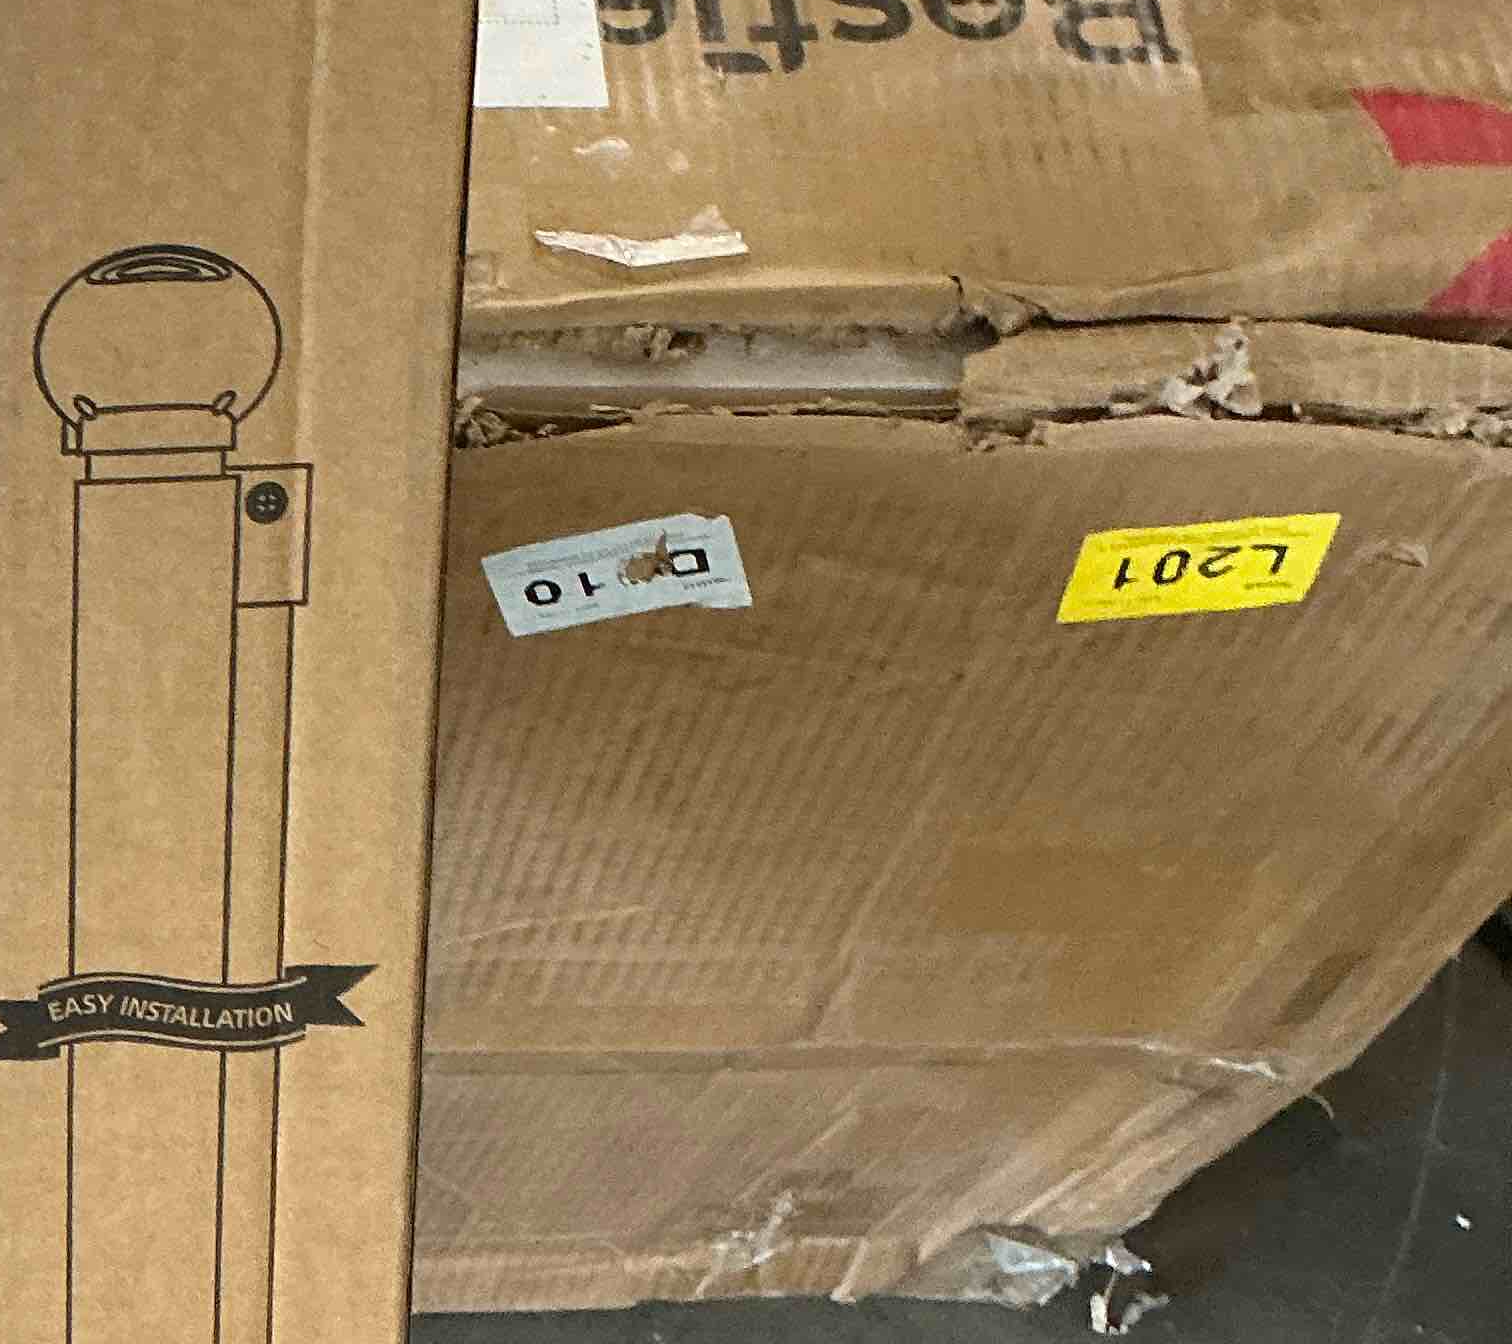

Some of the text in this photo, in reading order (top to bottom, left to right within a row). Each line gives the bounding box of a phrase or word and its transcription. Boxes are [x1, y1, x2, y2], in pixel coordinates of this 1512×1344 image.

[1112, 544, 1290, 591] L201
[47, 992, 295, 1030] EASY INSTALLATION
